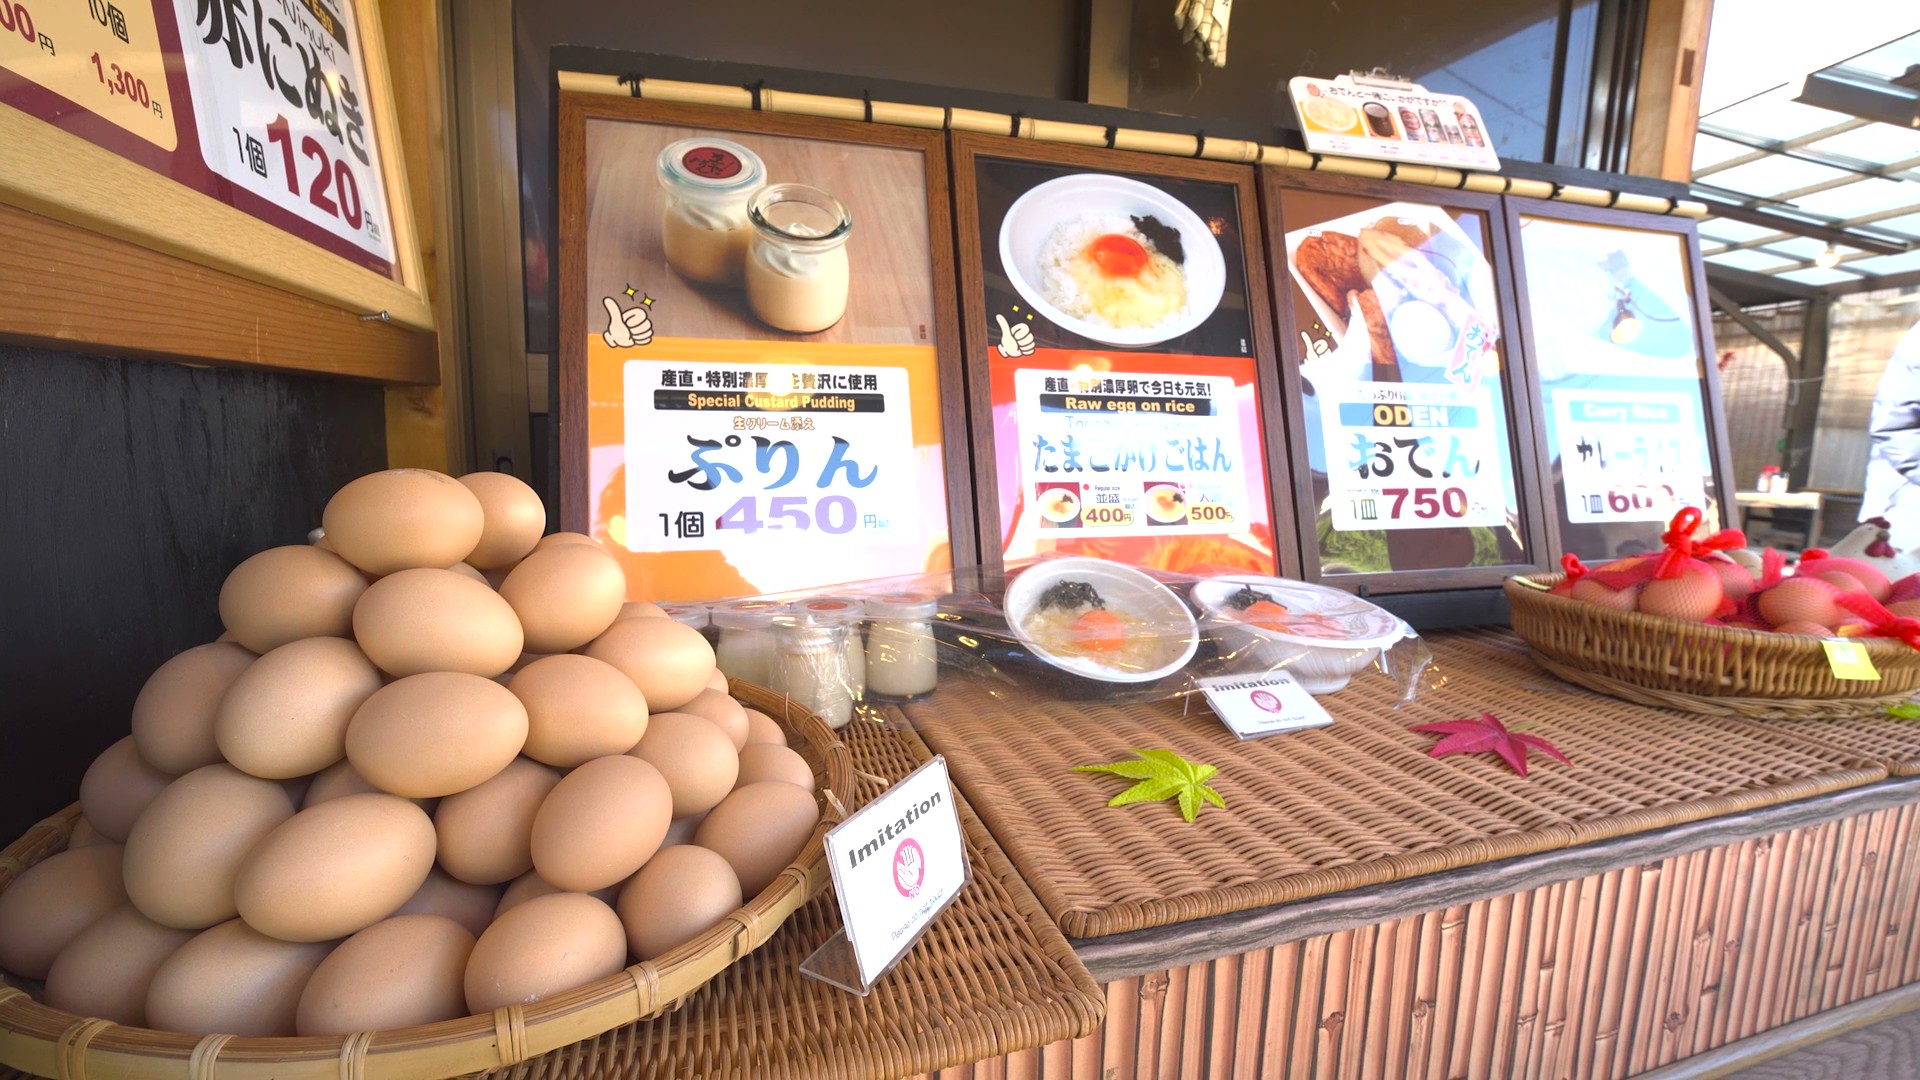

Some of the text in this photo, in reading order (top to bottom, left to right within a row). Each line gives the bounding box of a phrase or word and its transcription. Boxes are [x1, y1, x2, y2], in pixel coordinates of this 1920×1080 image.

[688, 393, 856, 412] Special Custard Pudding
[1065, 397, 1196, 414] Raw egg on rice
[1374, 404, 1449, 427] ODEN
[667, 434, 879, 491] ぷりん
[1348, 433, 1481, 480] おでん
[658, 511, 705, 538] 1個
[1211, 677, 1291, 692] Imitation
[849, 791, 942, 870] Imitation
